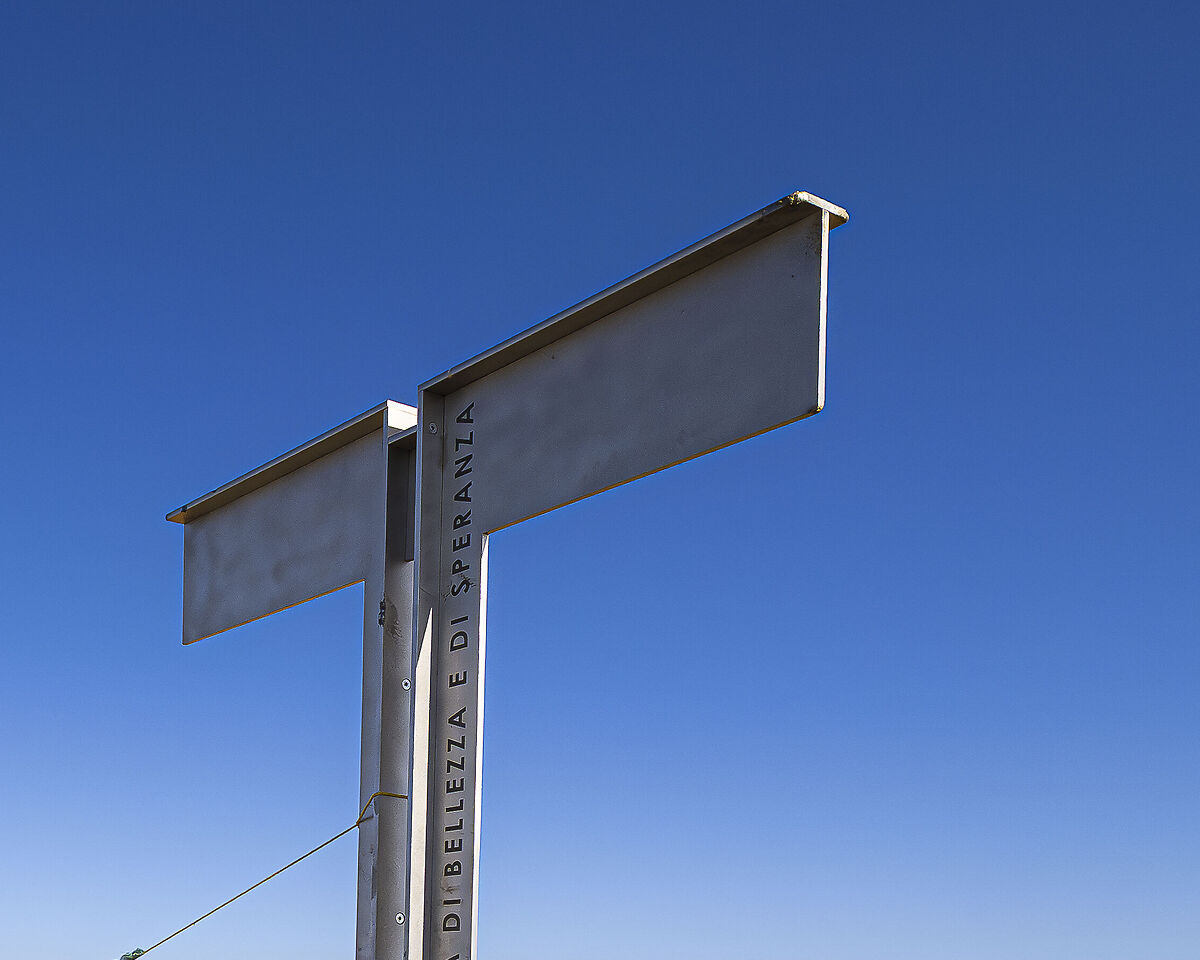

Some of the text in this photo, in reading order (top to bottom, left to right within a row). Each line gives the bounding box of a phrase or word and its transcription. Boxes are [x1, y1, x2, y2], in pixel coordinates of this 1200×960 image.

[450, 402, 475, 596] SPERANZA
[450, 616, 469, 652] DI
[448, 672, 468, 688] E
[443, 707, 466, 877] BELLEZZA
[442, 900, 461, 931] DI
